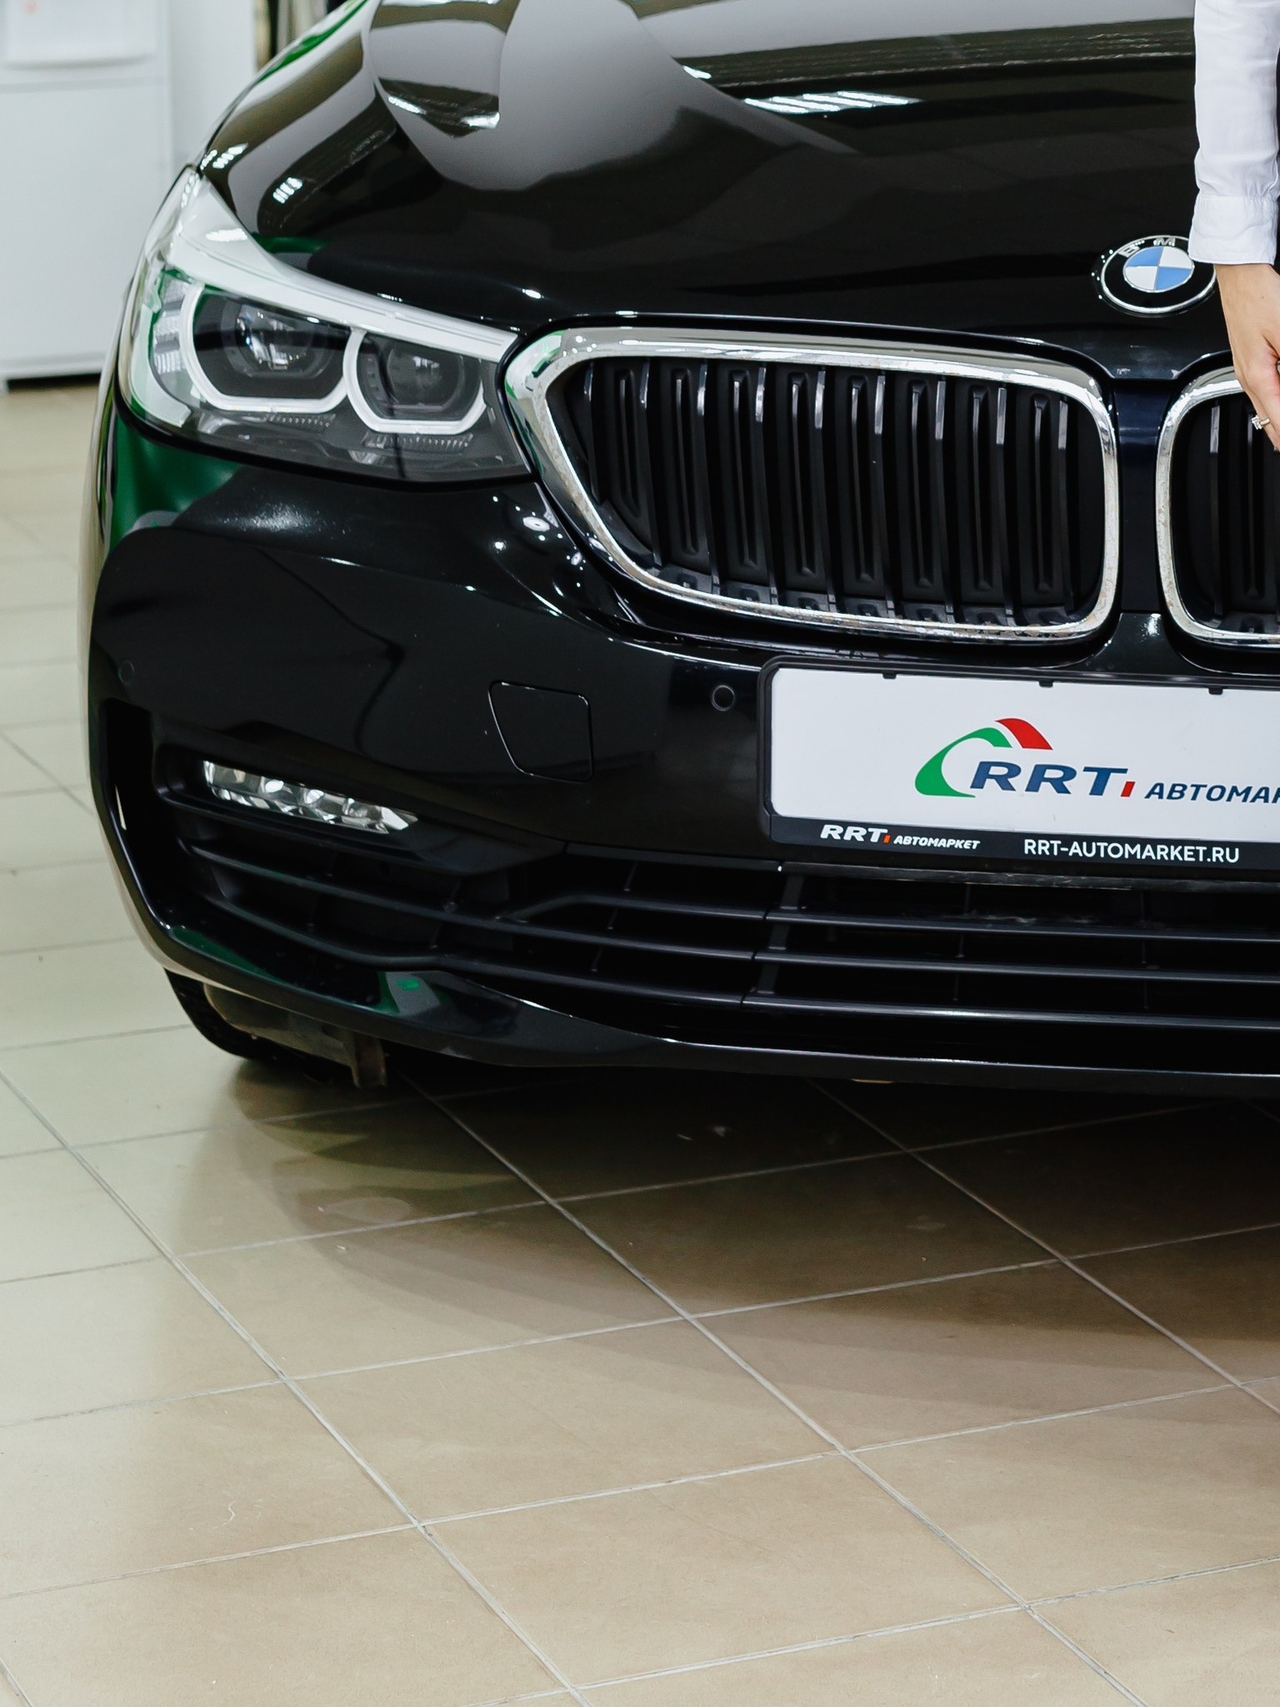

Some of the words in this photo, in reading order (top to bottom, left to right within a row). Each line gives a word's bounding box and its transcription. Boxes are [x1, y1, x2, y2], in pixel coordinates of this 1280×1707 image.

[1118, 237, 1177, 258] BM
[970, 760, 1129, 797] RRT
[820, 823, 889, 844] RRT
[893, 835, 981, 850] АВТОМАРКЕТ
[1023, 838, 1240, 864] RRT-AUTOMARKET.RU
